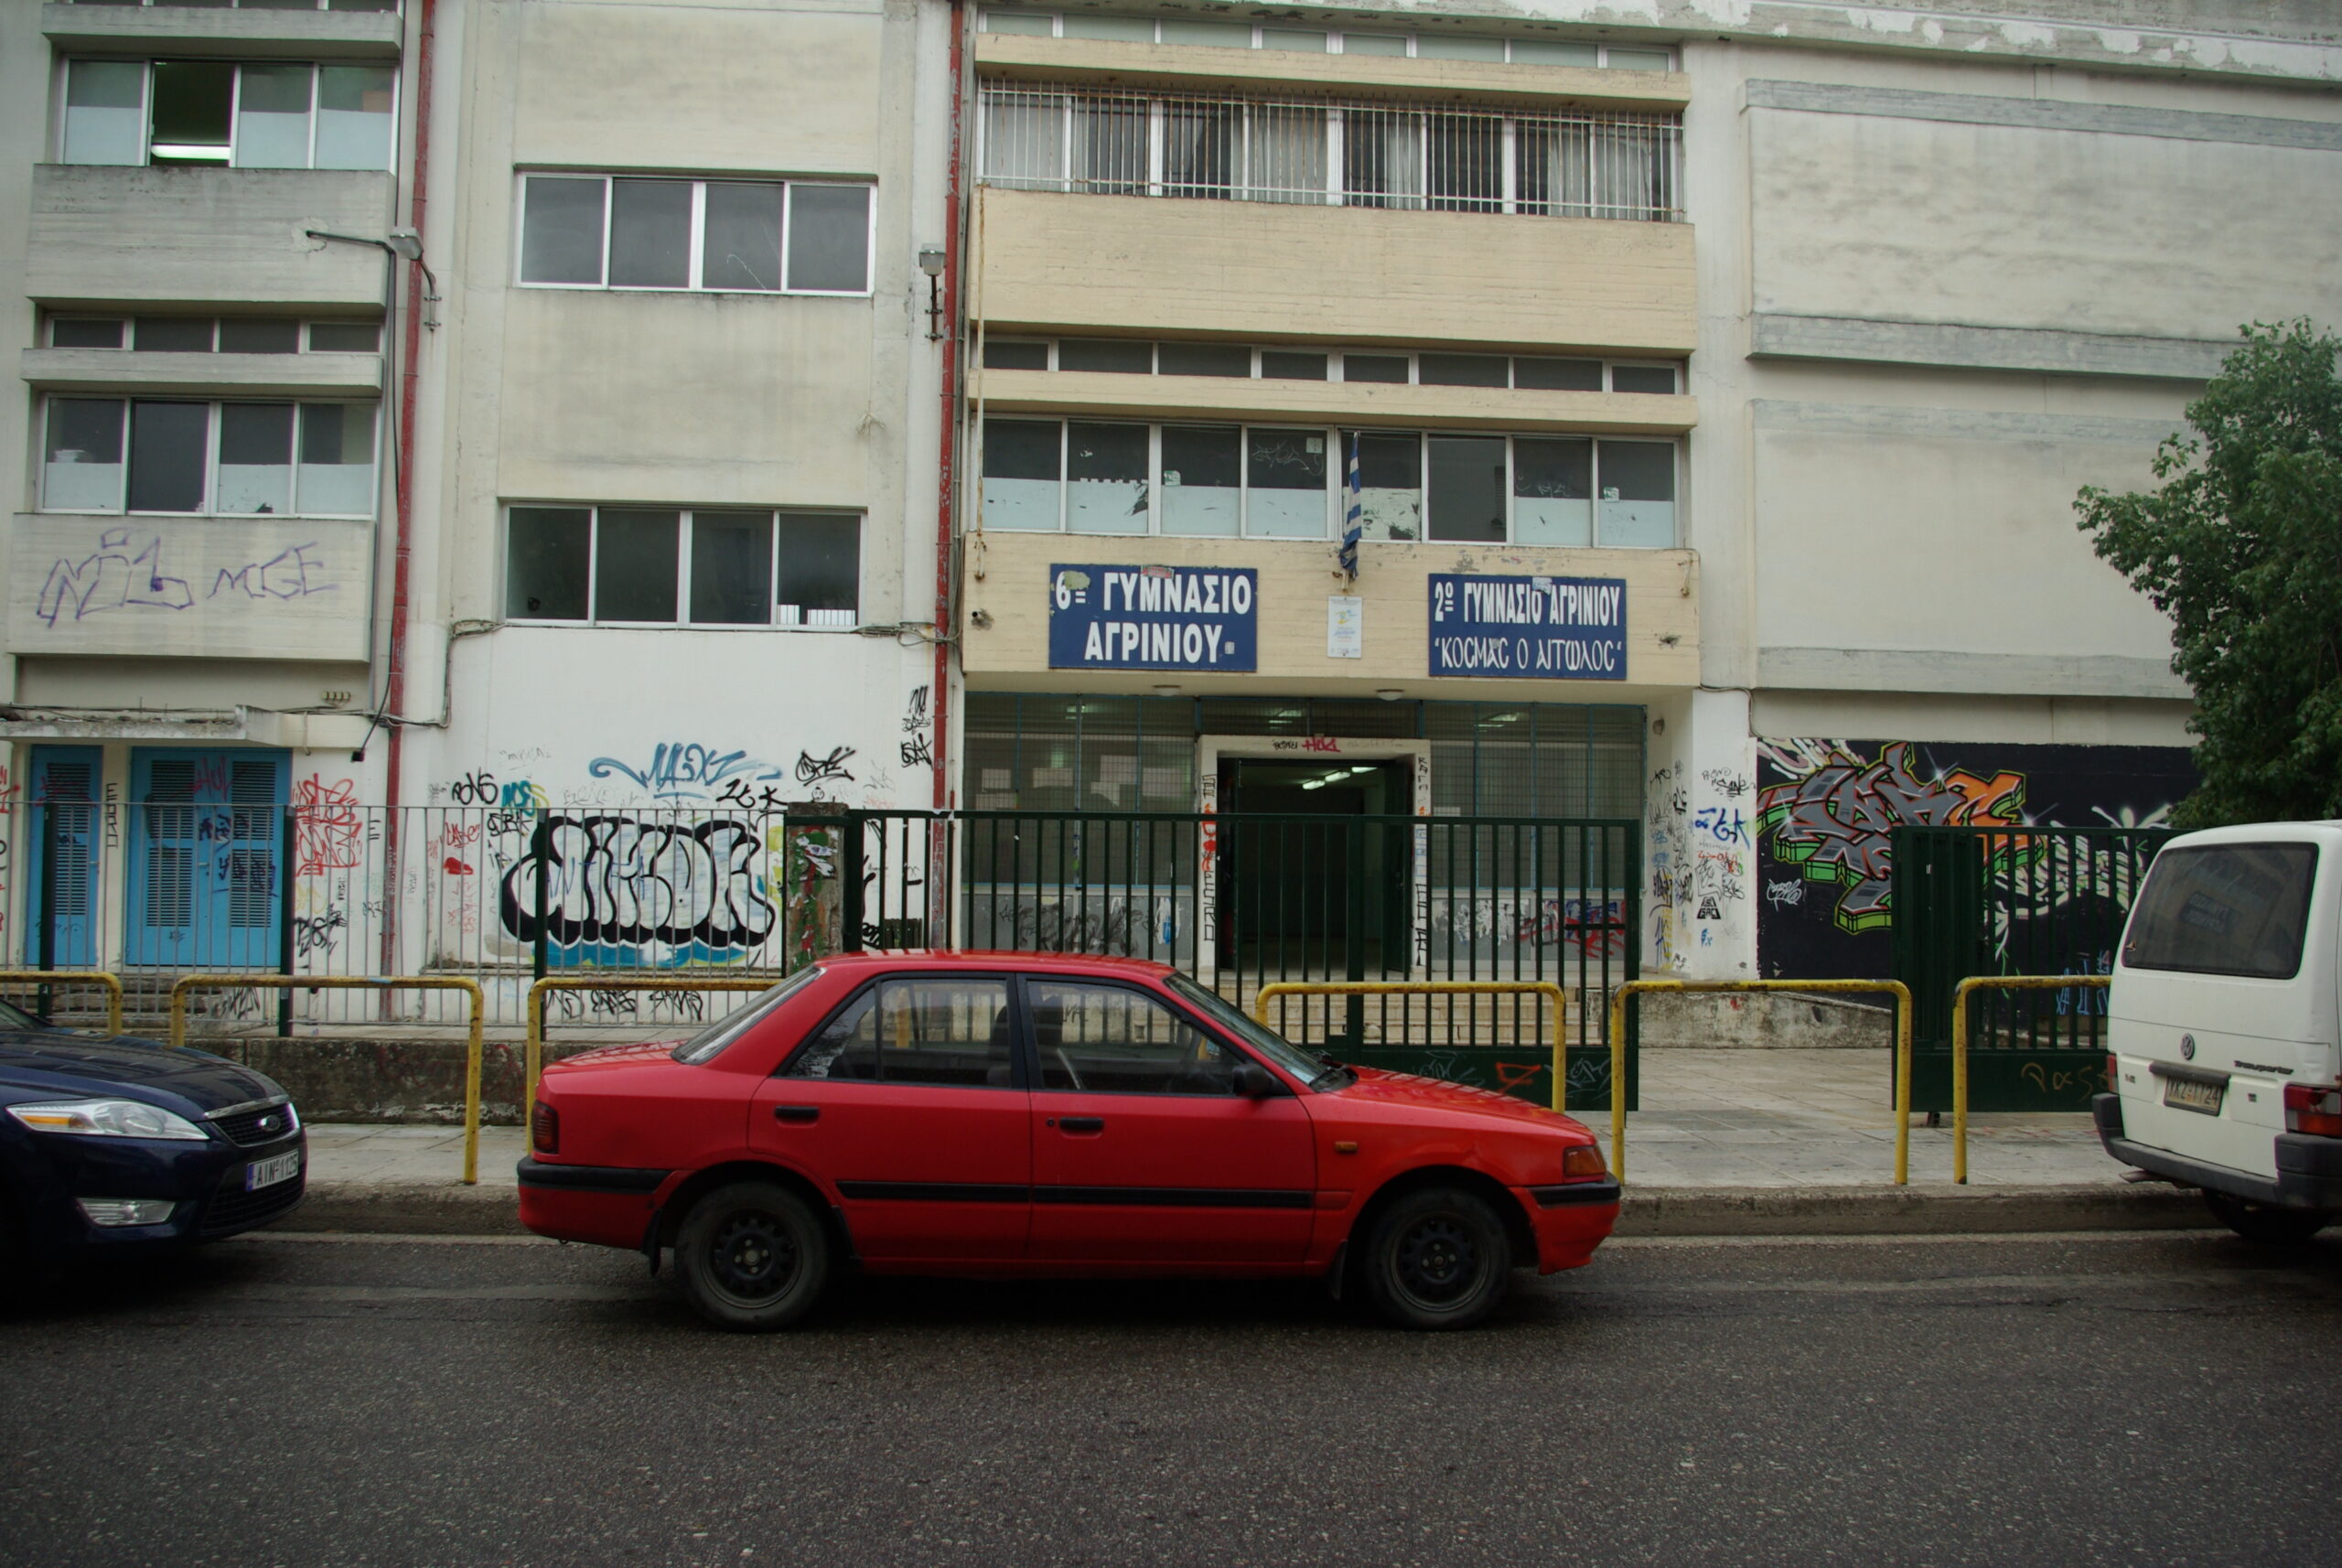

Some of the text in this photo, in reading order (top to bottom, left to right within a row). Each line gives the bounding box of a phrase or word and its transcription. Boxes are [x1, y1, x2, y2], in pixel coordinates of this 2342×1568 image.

[1103, 572, 1252, 615] ΓΥΜΝΑΣΙΟ
[1464, 582, 1542, 625] ΓΥΜΝΑΣΙΟ
[1549, 585, 1620, 627] ΑΓΡΙΝΙΟΥ
[1084, 621, 1223, 663] ΑΓΡΙΝΙΟΥ
